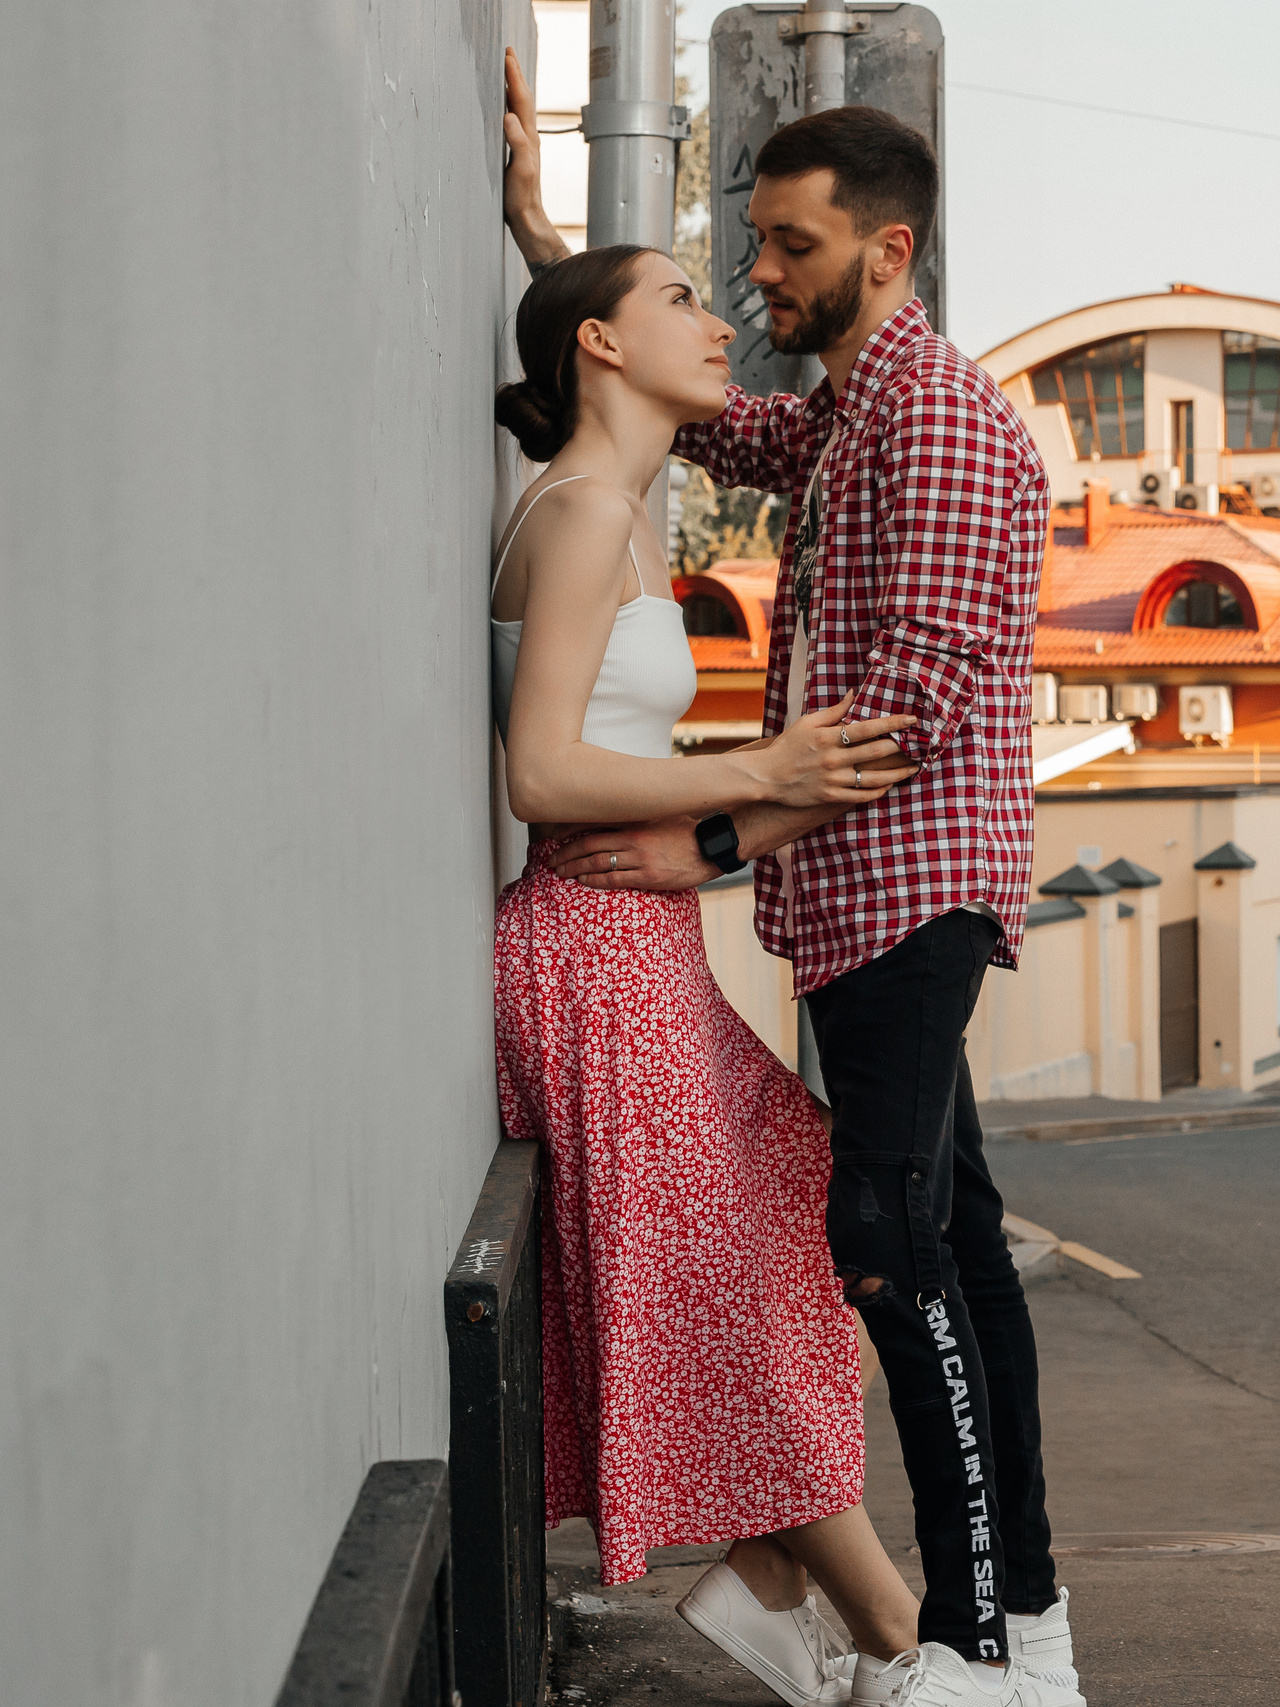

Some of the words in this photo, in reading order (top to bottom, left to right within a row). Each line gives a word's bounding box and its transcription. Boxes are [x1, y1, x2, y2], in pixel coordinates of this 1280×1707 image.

[942, 1354, 977, 1449] CALM
[964, 1453, 984, 1485] IN
[967, 1489, 991, 1552] THE
[973, 1558, 995, 1624] SEA
